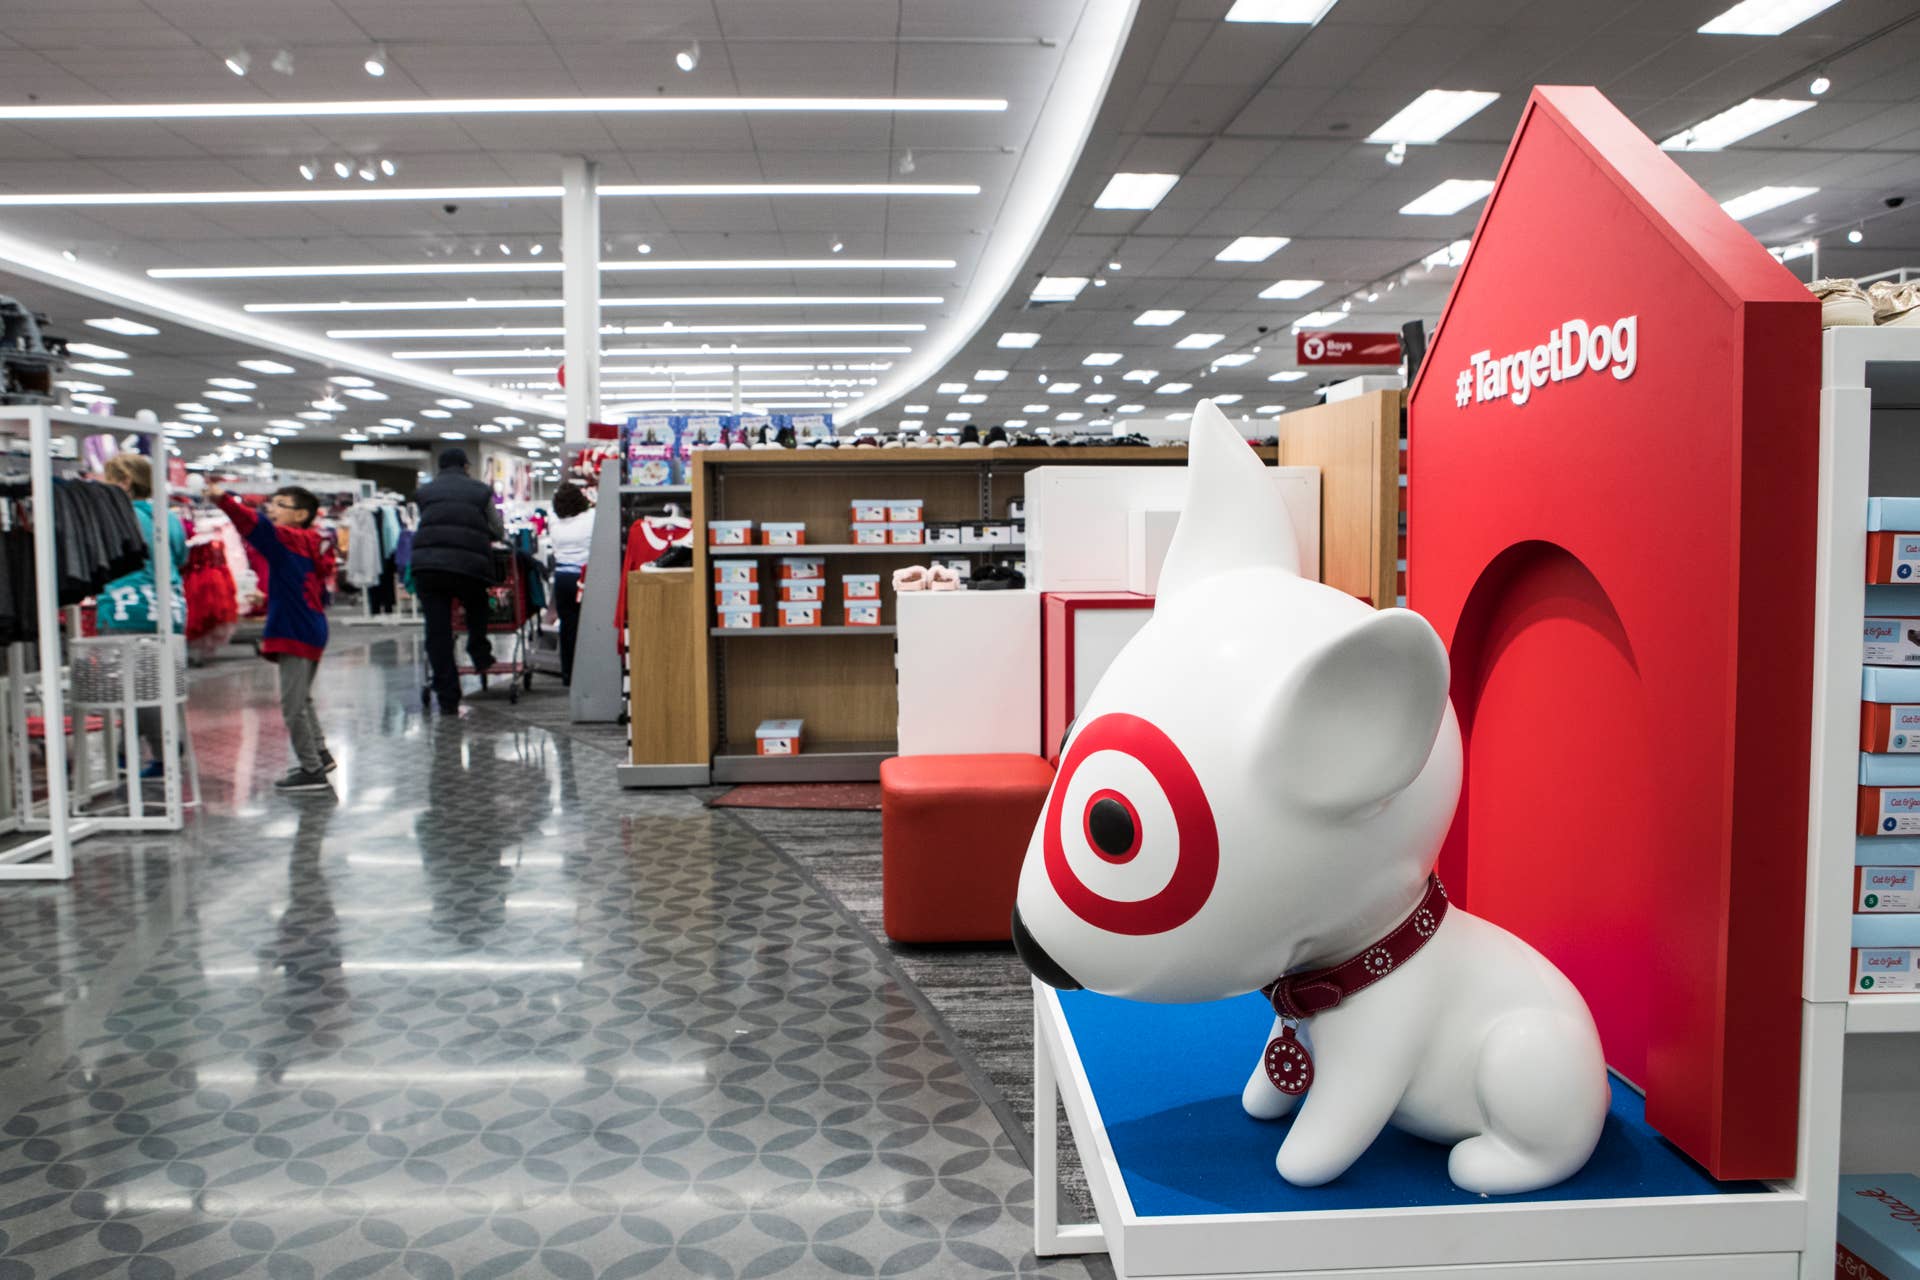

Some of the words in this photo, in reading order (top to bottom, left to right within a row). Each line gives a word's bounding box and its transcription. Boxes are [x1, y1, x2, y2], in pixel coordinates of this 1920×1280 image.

[1326, 340, 1353, 352] Boys
[1455, 315, 1637, 408] #TargetDog
[1891, 798, 1902, 807] Cat
[1872, 875, 1883, 884] Cat
[1889, 875, 1907, 887] Jack
[1868, 958, 1879, 966] Cat
[1884, 957, 1903, 968] Jack
